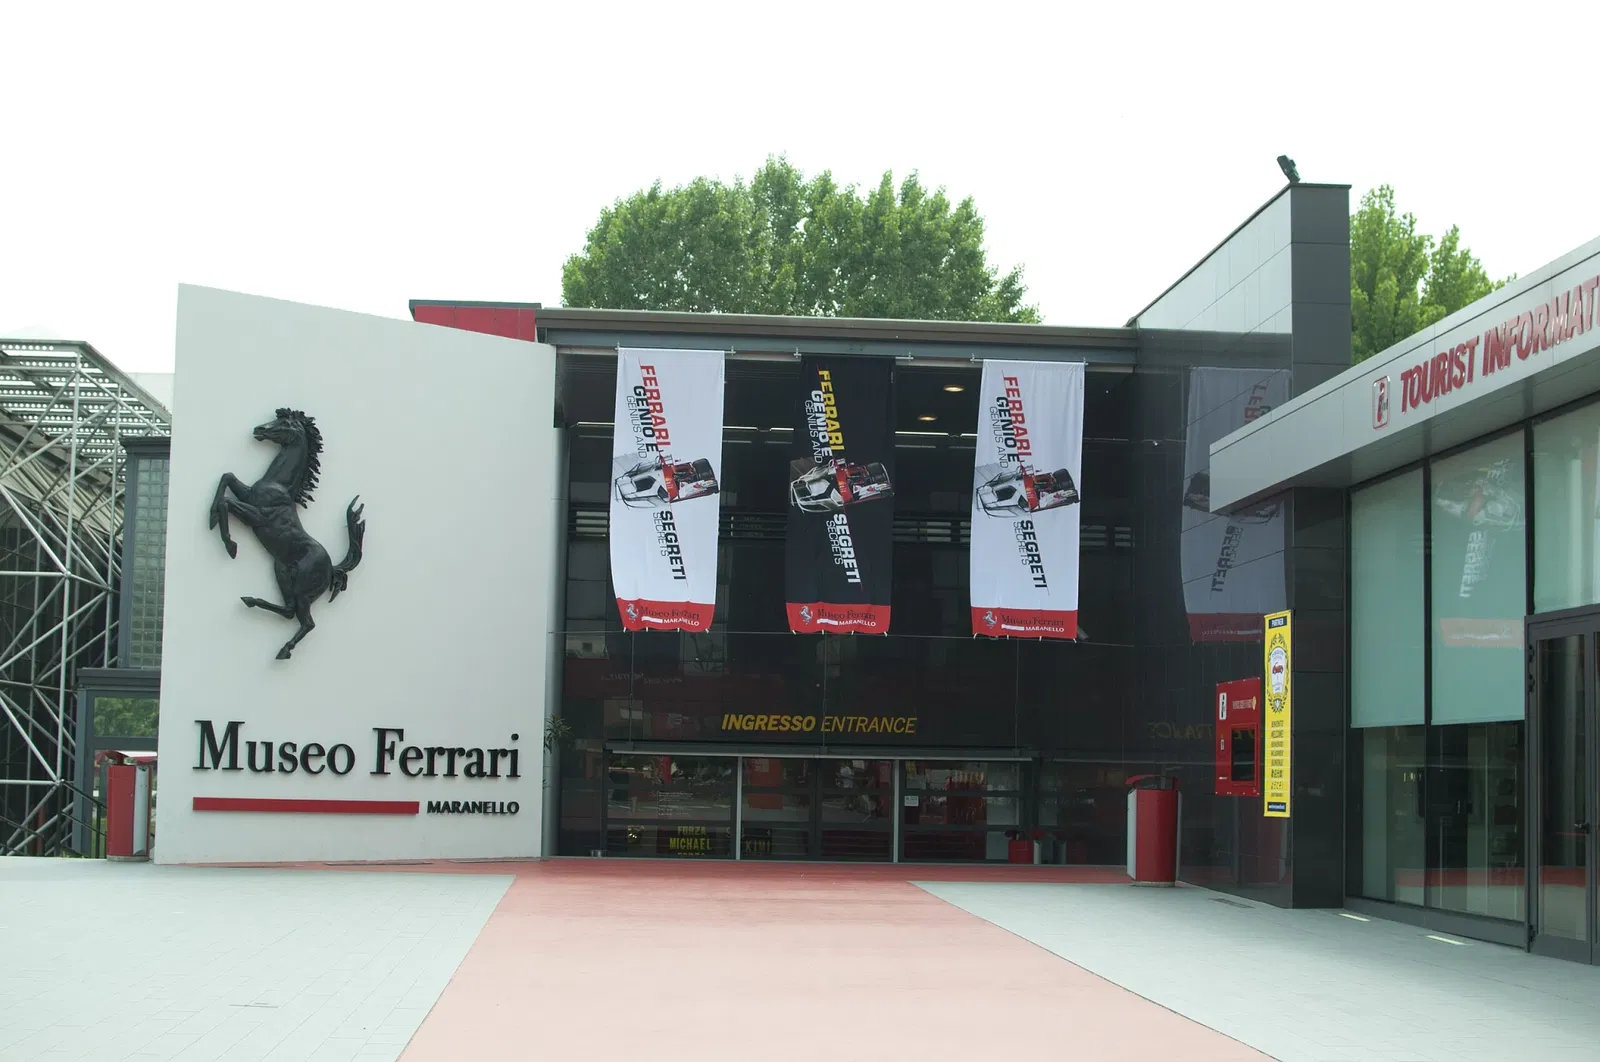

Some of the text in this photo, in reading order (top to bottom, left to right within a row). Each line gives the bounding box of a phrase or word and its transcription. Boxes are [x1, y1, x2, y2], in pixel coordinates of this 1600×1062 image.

[1400, 335, 1480, 414] TOURIST
[626, 395, 648, 459] GENIUS AND
[633, 385, 659, 452] GENIO E
[640, 365, 671, 446] FERRARI
[804, 400, 823, 464] GENIUS AND
[811, 390, 833, 457] GENIO E
[818, 370, 845, 450] FERRARI
[996, 396, 1020, 462] GENIO E
[1003, 376, 1032, 456] FERRARI
[989, 406, 1009, 469] GENIUS AND
[652, 512, 669, 557] SECRETS
[660, 510, 687, 580] SEGRETI
[826, 520, 844, 565] SECRETS
[833, 513, 861, 583] SEGRETI
[1013, 521, 1030, 566] SECRETS
[1020, 519, 1048, 588] SEGRETI
[640, 606, 700, 620] Museo Ferrari
[663, 617, 700, 627] MARANELLO
[817, 608, 876, 621] Museo Ferrari
[838, 619, 876, 627] MARANELLO
[1001, 614, 1064, 626] Museo Ferrari
[192, 719, 522, 778] Museo Ferrari
[721, 714, 918, 734] INGRESSO ENTRANCE
[426, 800, 520, 815] MARANELLO
[677, 825, 707, 836] FORZA
[669, 837, 712, 850] MICHAEL
